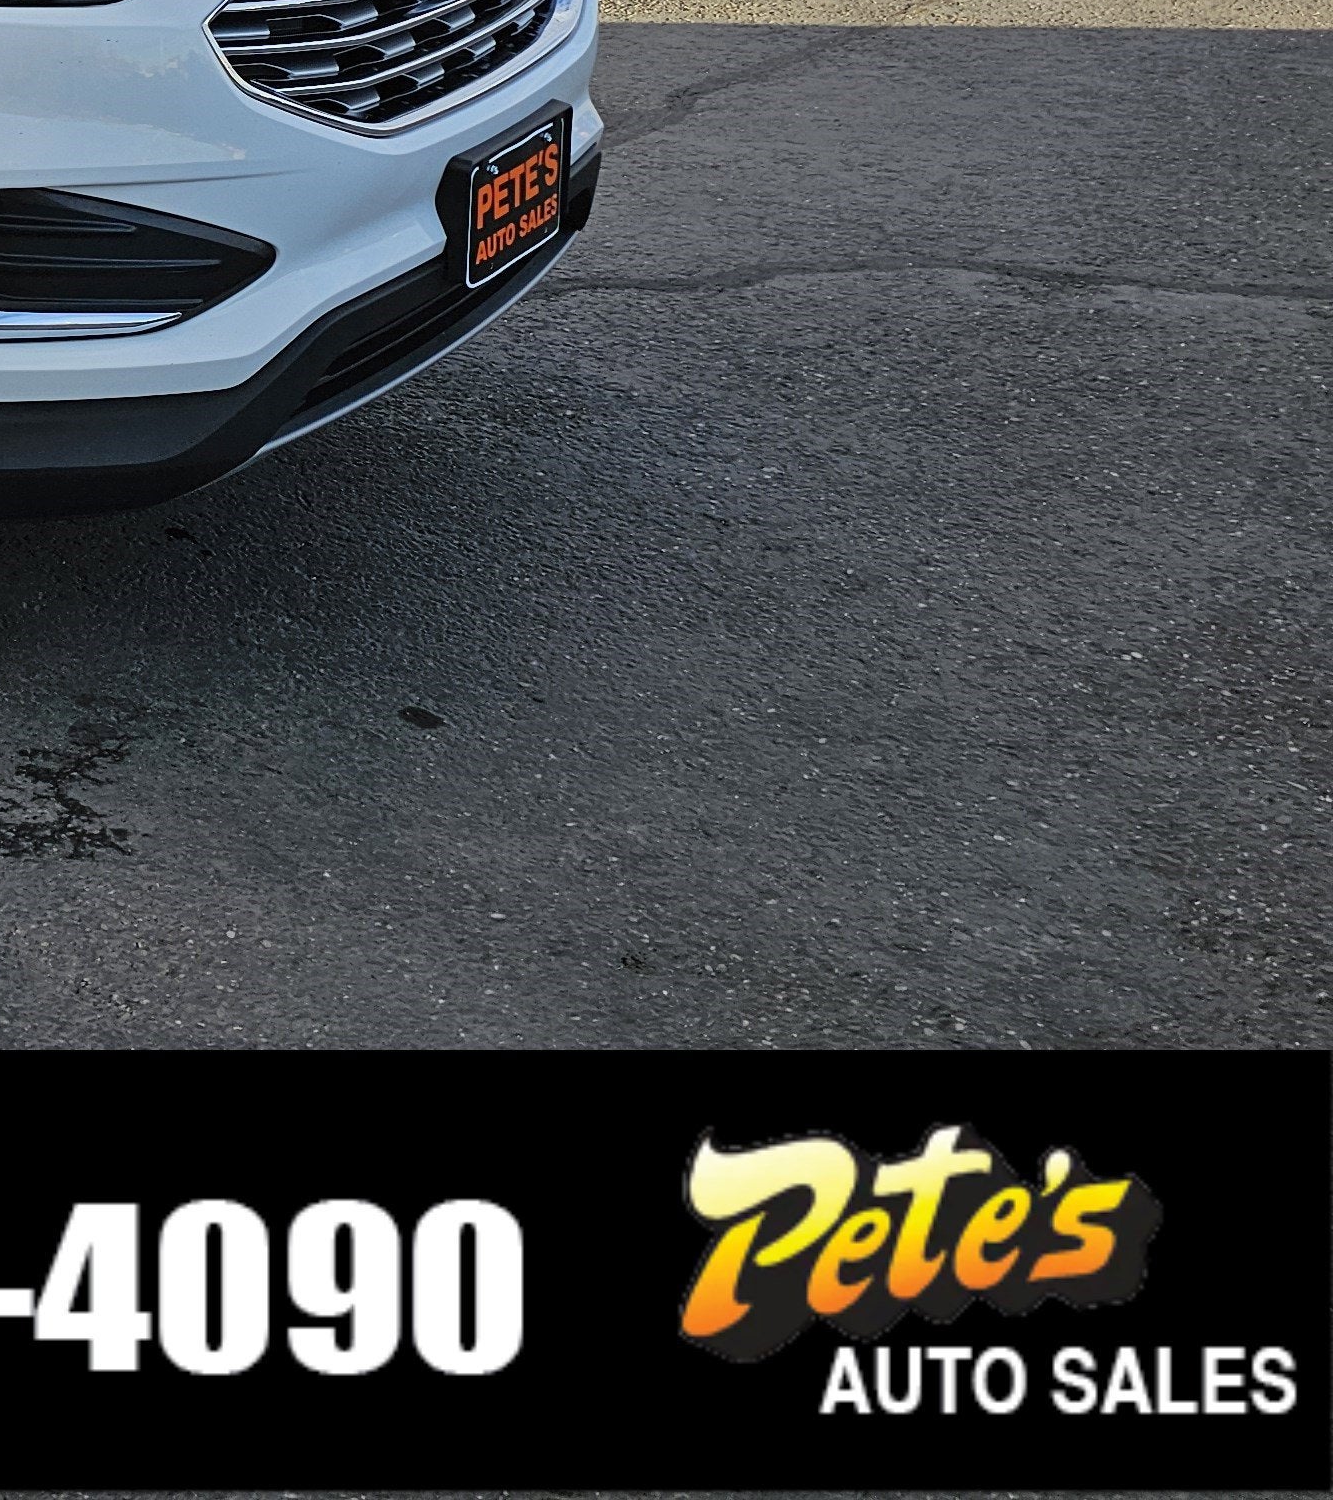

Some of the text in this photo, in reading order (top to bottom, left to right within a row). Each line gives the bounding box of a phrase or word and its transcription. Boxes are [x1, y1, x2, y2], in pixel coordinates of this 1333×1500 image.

[476, 143, 559, 230] PETE'S
[475, 193, 558, 265] AUTO SALES
